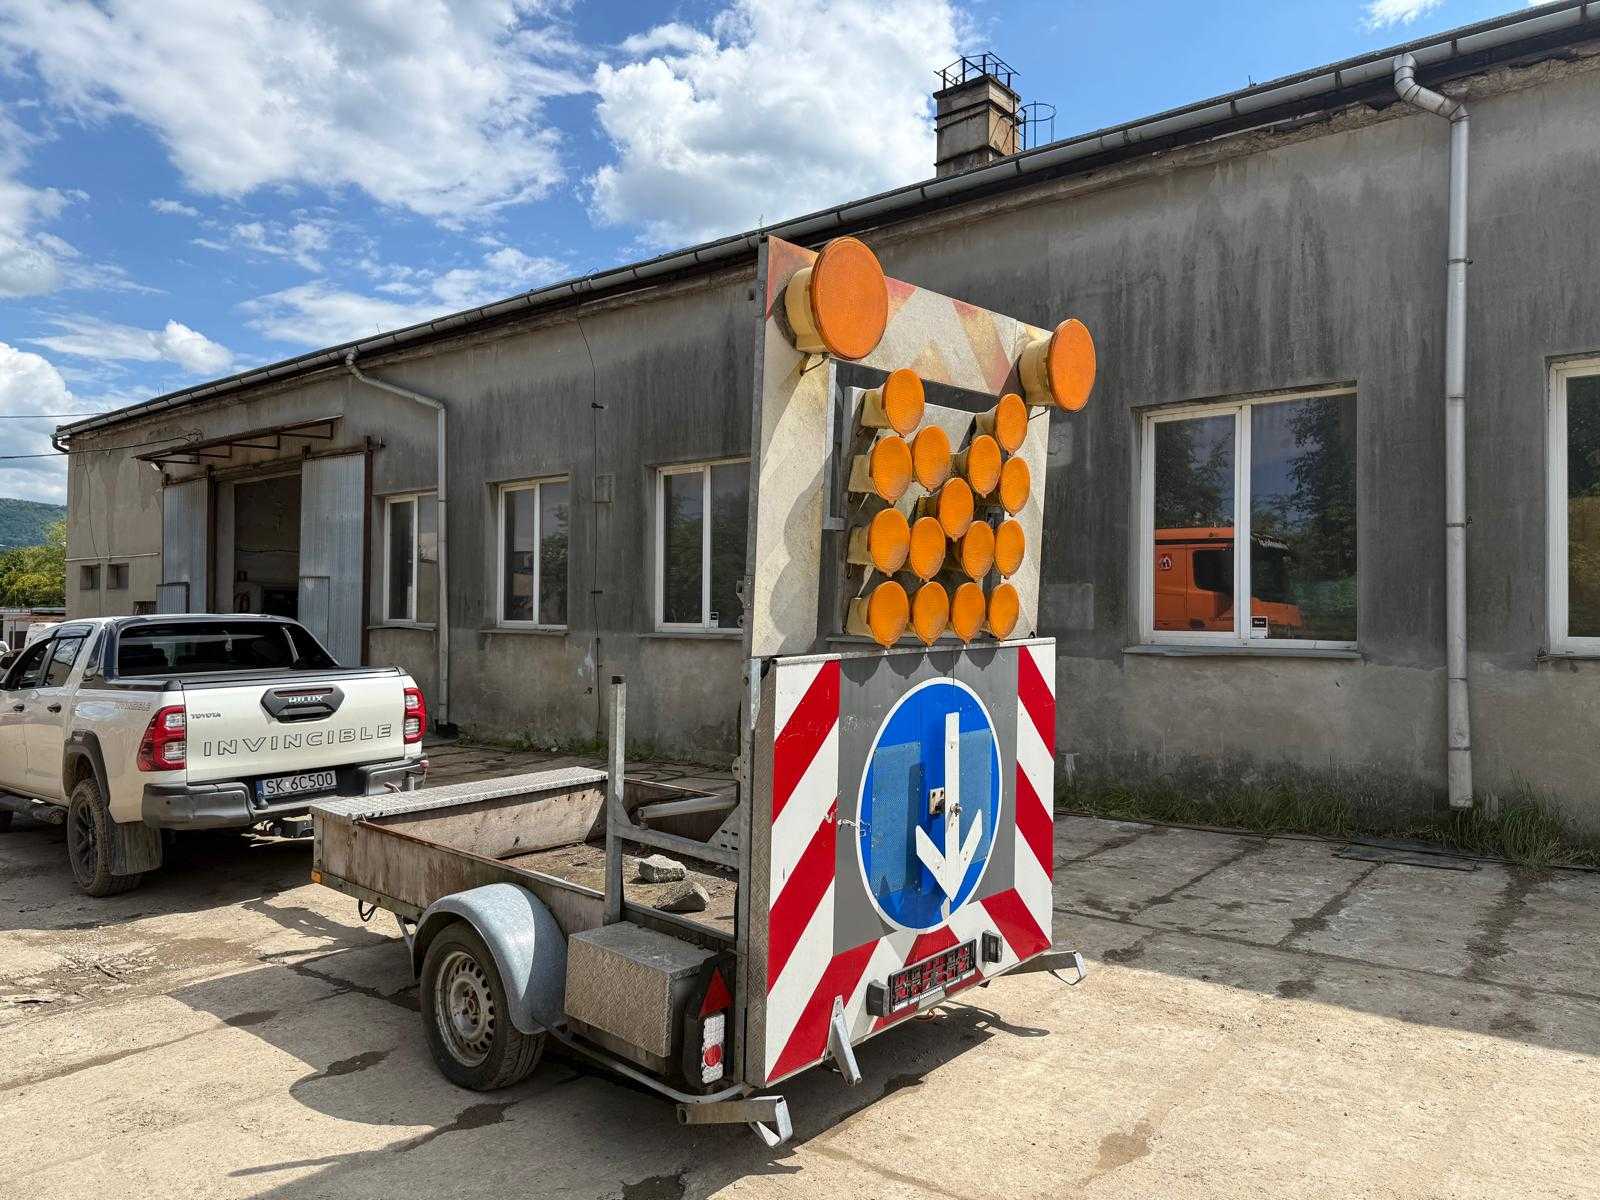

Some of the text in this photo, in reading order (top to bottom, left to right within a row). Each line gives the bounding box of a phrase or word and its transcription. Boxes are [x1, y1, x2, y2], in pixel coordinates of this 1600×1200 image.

[203, 723, 392, 757] INVINCIBLE
[266, 772, 334, 794] SK 6C500
